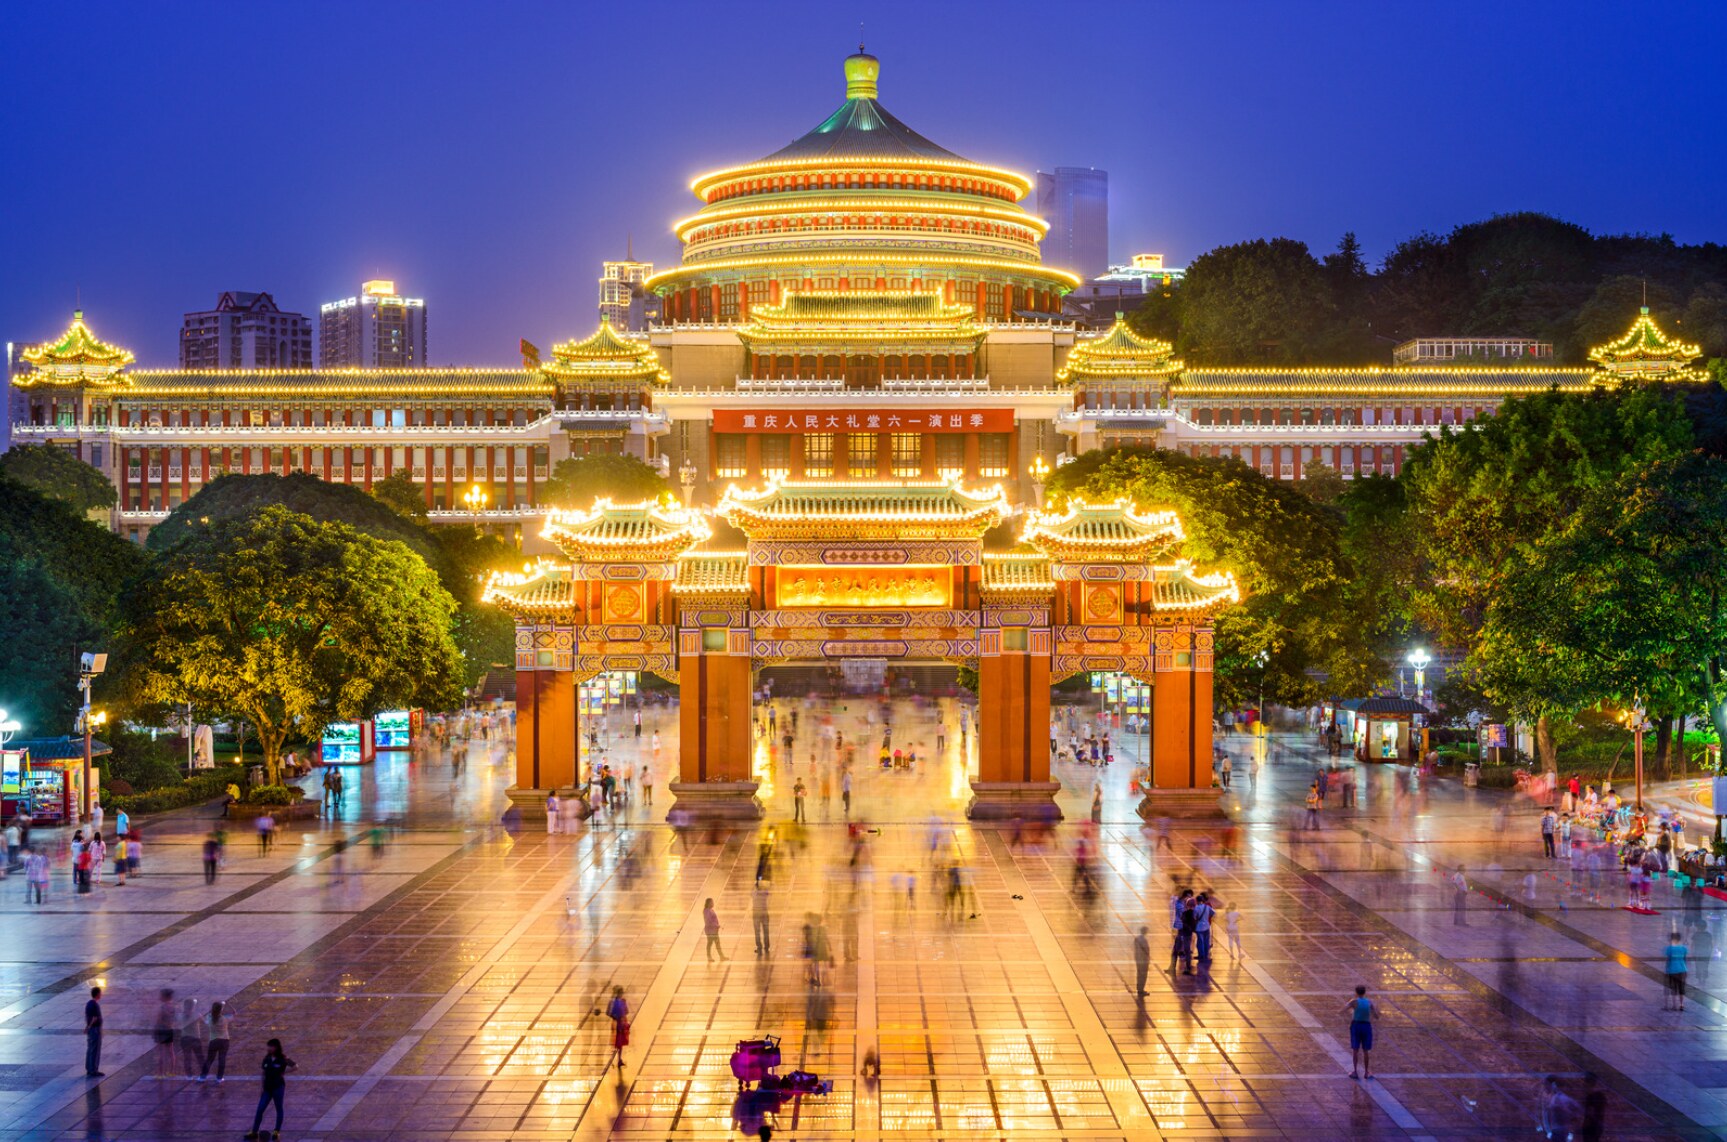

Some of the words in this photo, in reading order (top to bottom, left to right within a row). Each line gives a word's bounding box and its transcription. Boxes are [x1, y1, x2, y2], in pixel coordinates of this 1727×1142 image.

[743, 414, 985, 428] 重庆人民大礼堂六一演出季
